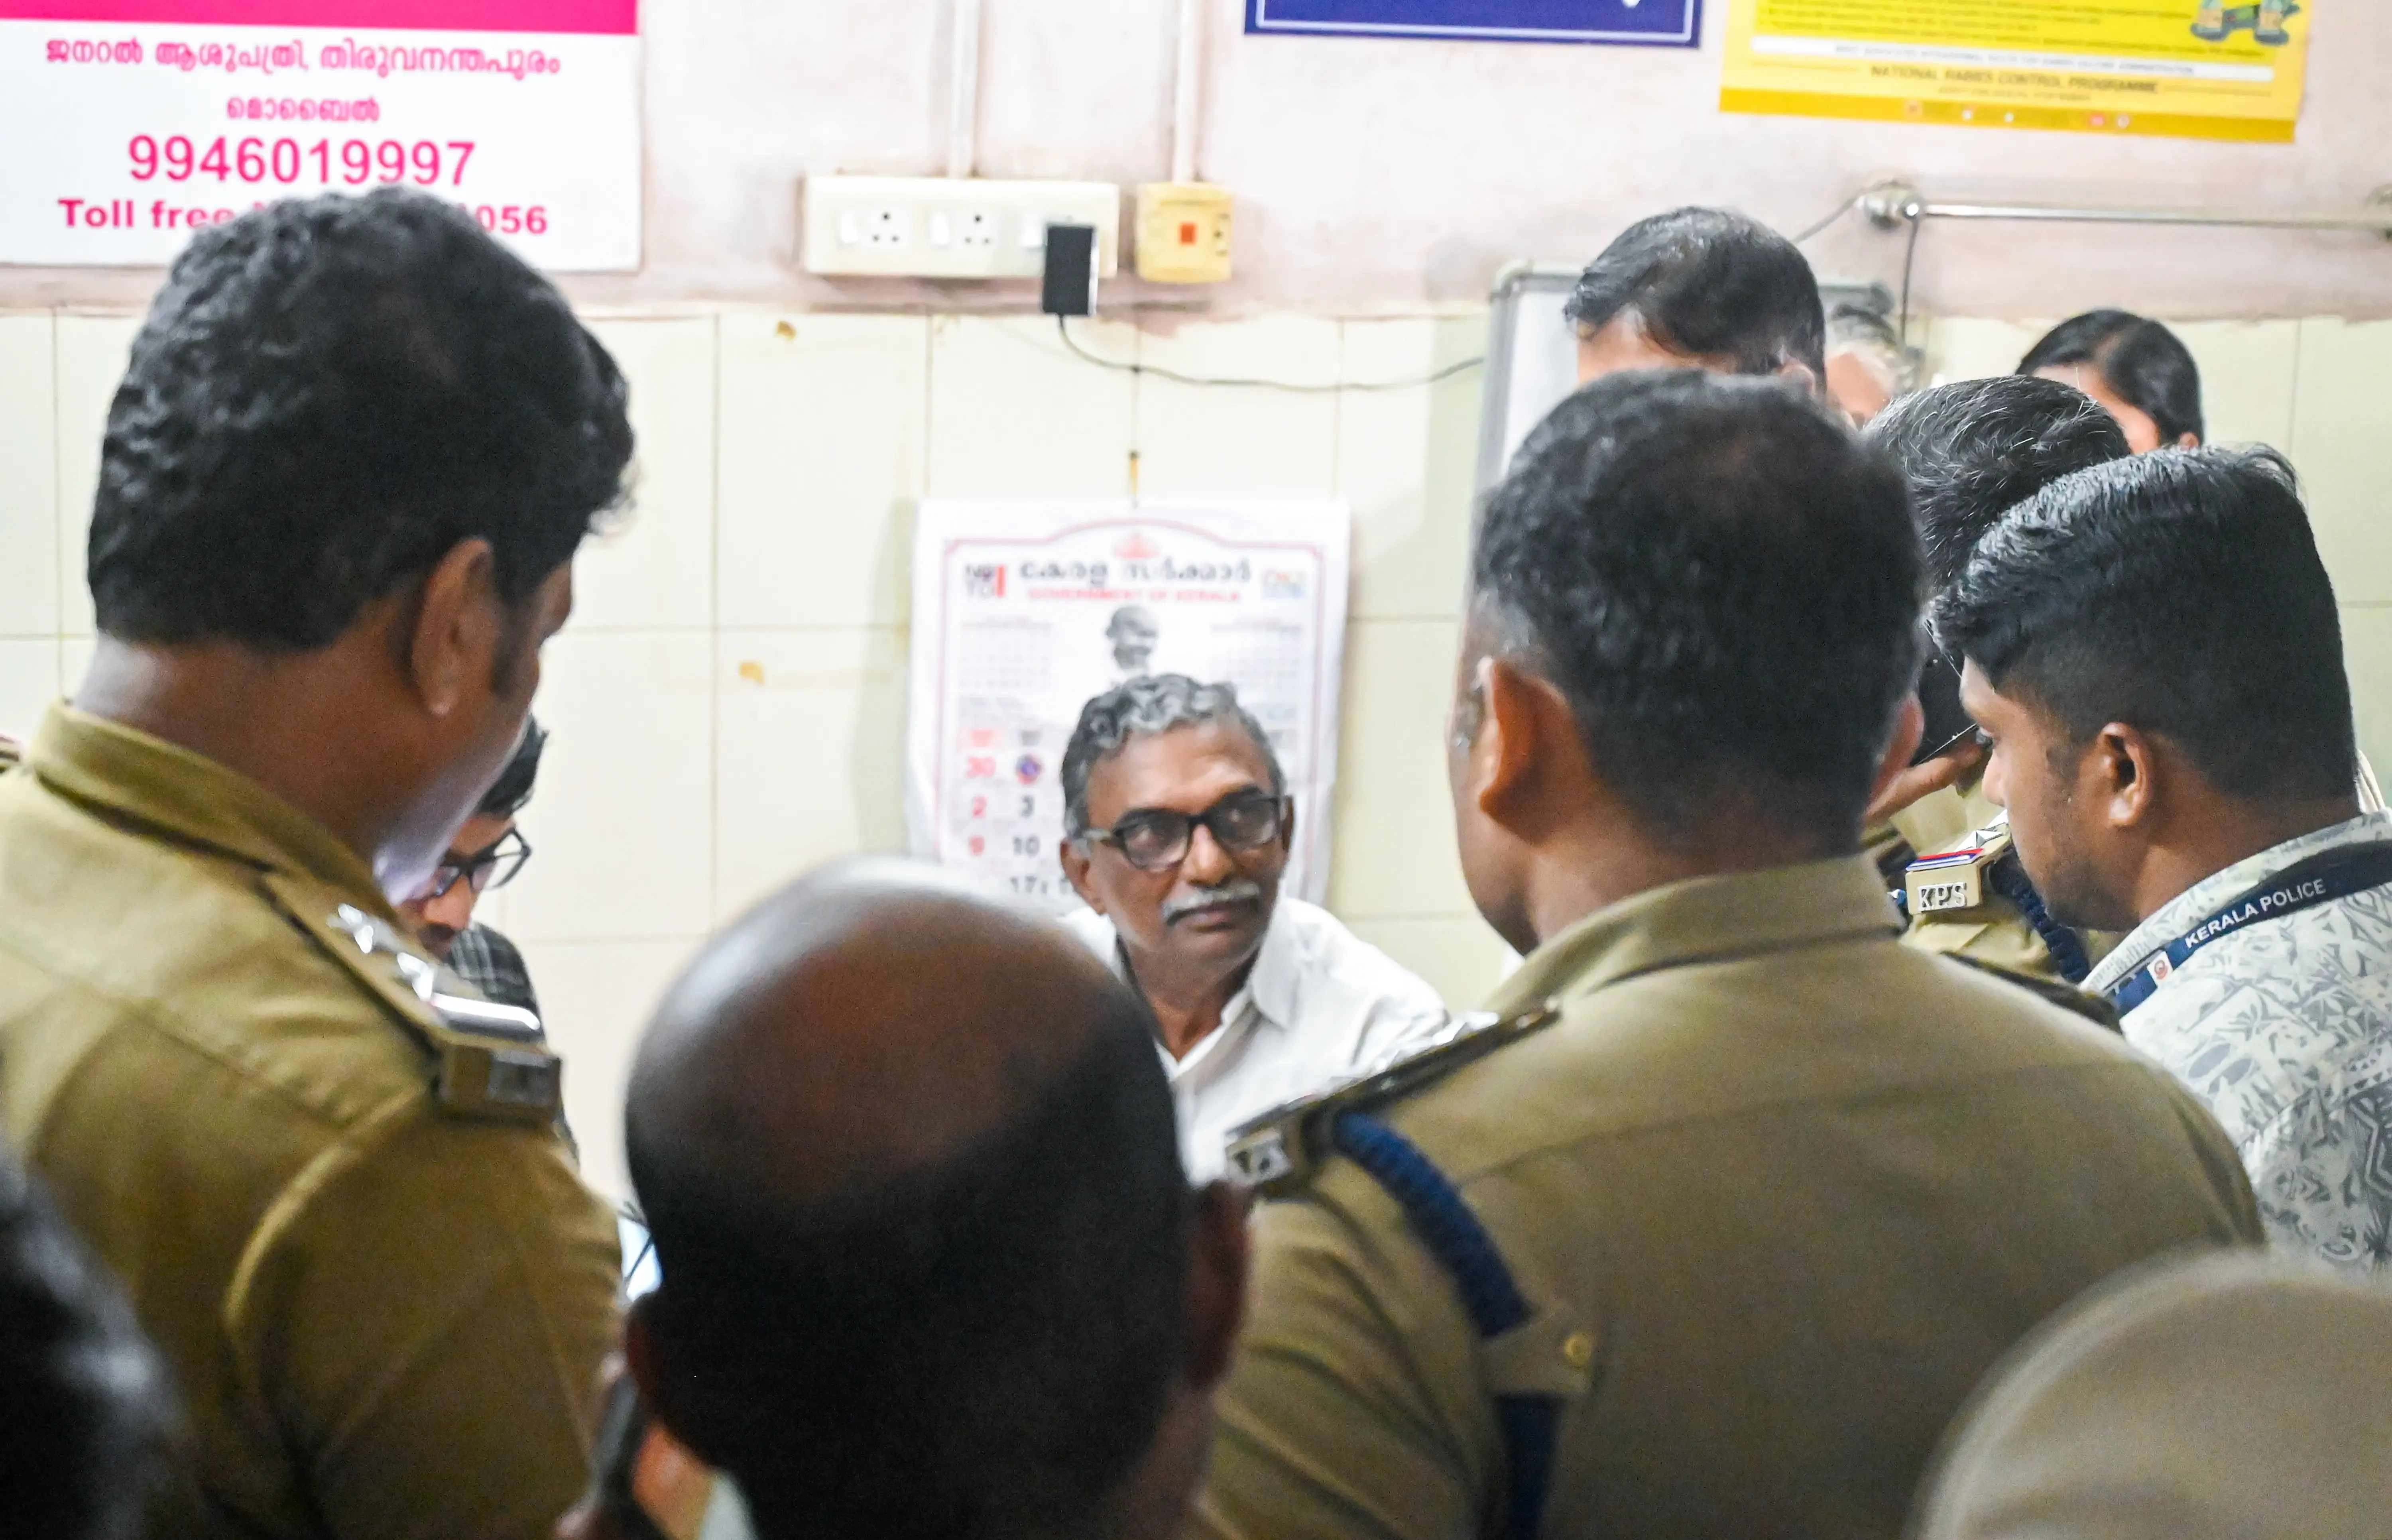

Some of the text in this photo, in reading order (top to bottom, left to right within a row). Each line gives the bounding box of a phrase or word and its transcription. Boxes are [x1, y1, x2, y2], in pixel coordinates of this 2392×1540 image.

[128, 134, 475, 186] 9946019997
[57, 198, 135, 228] Toll
[458, 202, 548, 235] 056
[1013, 836, 1040, 858] 10
[2184, 878, 2327, 948] KERALA POLICE
